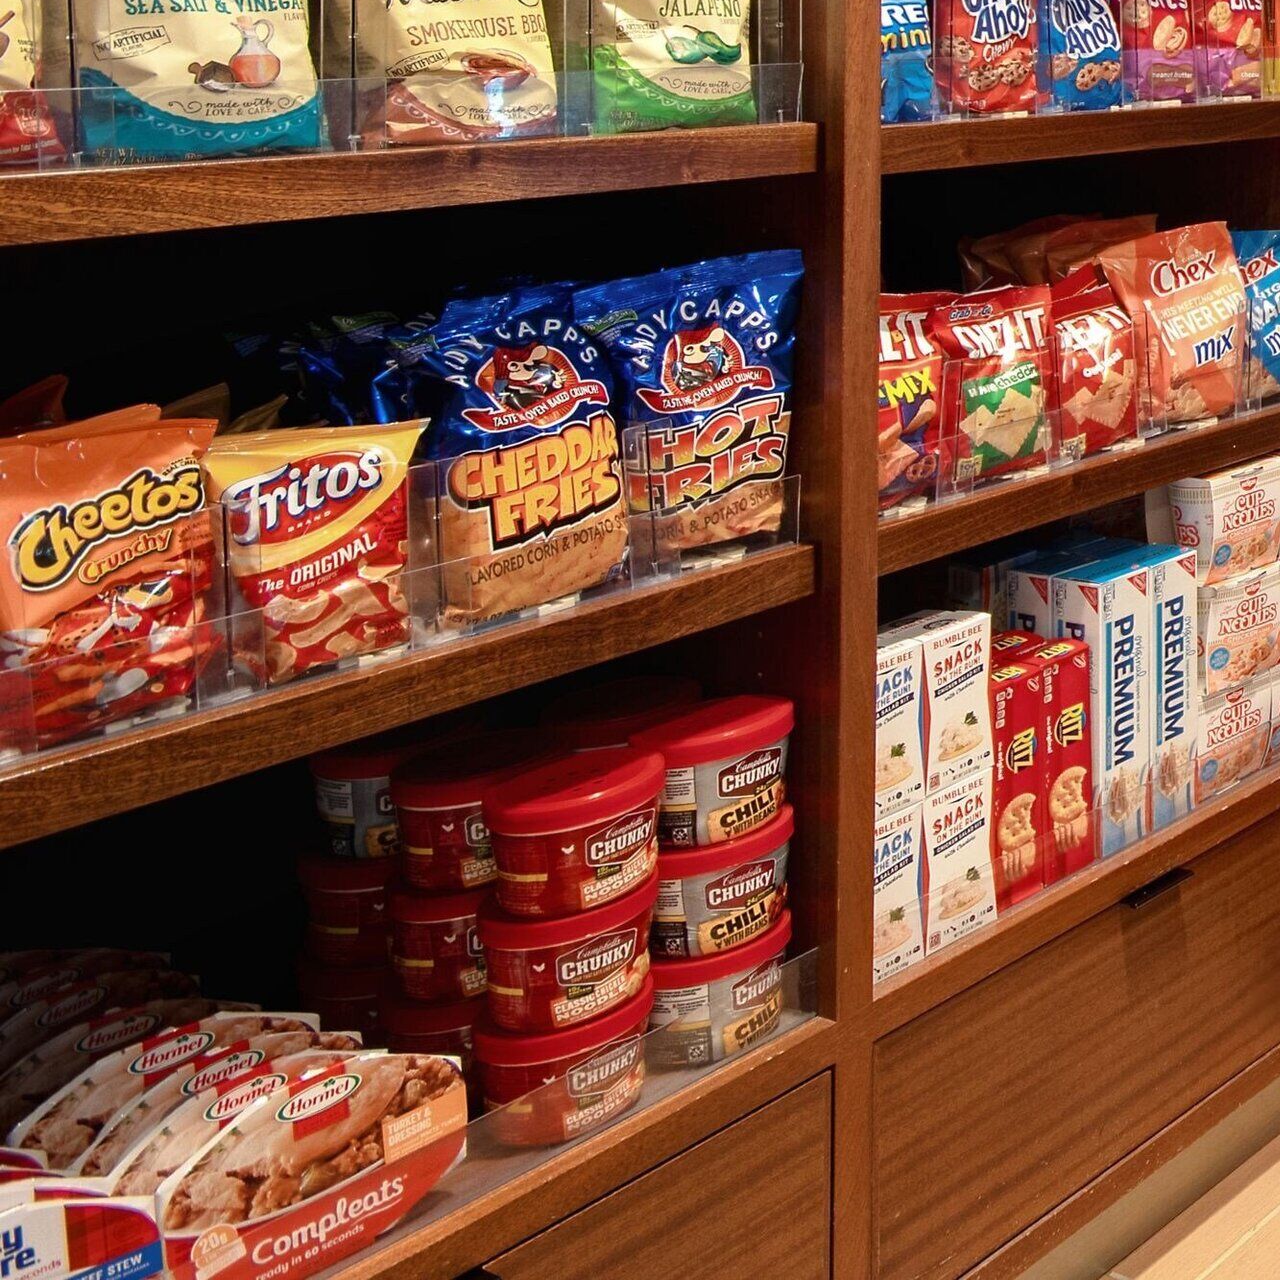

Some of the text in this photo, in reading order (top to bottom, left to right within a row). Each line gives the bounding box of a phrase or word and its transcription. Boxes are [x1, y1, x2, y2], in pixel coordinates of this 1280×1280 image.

[113, 29, 164, 49] ARTIFICIAL
[407, 14, 547, 47] SMOKEHOUSE BBQ
[404, 53, 447, 76] ARTIFICIAL
[205, 108, 234, 117] LOVE
[206, 98, 239, 109] made
[1152, 252, 1216, 295] Chex
[496, 319, 598, 365] CAPP'S
[680, 300, 778, 352] CAPP'S
[1163, 308, 1214, 341] NEVER
[1195, 326, 1235, 366] mix
[493, 384, 600, 427] TASTE OVEN BAKED CRUNCH!
[692, 371, 763, 404] OVEN BAKED CRUNCH!
[649, 401, 782, 472] HOT
[455, 413, 619, 501] CHEDDAR
[628, 437, 784, 511] FRIES
[223, 451, 382, 545] Fritos
[496, 465, 621, 539] FRIES
[703, 503, 748, 526] POTATO
[20, 469, 203, 585] Cheetos
[287, 510, 332, 533] BRAND
[78, 528, 172, 584] Crunchy
[258, 533, 378, 593] The ORIGINAL
[526, 523, 615, 566] CORN POTATO
[1218, 603, 1278, 637] NOODLES
[1236, 593, 1268, 616] CUP
[933, 623, 983, 650] BUMBLE BEE
[933, 638, 983, 679] SNACK
[937, 667, 963, 686] ON THE
[1164, 595, 1185, 741] PREMIUM
[1114, 613, 1135, 766] PREMIUM
[1062, 701, 1085, 748] RITZ
[1206, 708, 1262, 748] NOODLES
[1220, 699, 1252, 725] CUP
[1012, 726, 1036, 774] RITZ
[721, 756, 780, 793] CHUNKY
[932, 778, 984, 807] BUMBLE BEE
[720, 788, 774, 828] CHILI
[732, 803, 777, 835] WITH BEANS
[933, 792, 984, 836] SNACK
[590, 819, 652, 860] CHUNKY
[936, 823, 964, 844] ON THE
[584, 870, 624, 894] CLASSIC
[708, 868, 773, 906] CHUNKY
[710, 899, 767, 940] CHILI
[724, 915, 770, 947] WITH BEANS
[561, 938, 633, 980] CHUNKY
[555, 992, 596, 1015] CLASSIC
[734, 1001, 779, 1040] CHILI
[142, 1035, 204, 1073] Hormel
[573, 1046, 637, 1091] CHUNKY
[214, 1076, 278, 1118] Hormel
[281, 1079, 351, 1119] Hormel
[387, 1113, 421, 1135] TURKEY
[388, 1118, 432, 1148] DRESSING
[252, 1176, 404, 1265] Compleats
[107, 1253, 144, 1276] STEW
[291, 1223, 365, 1267] in 60 seconds
